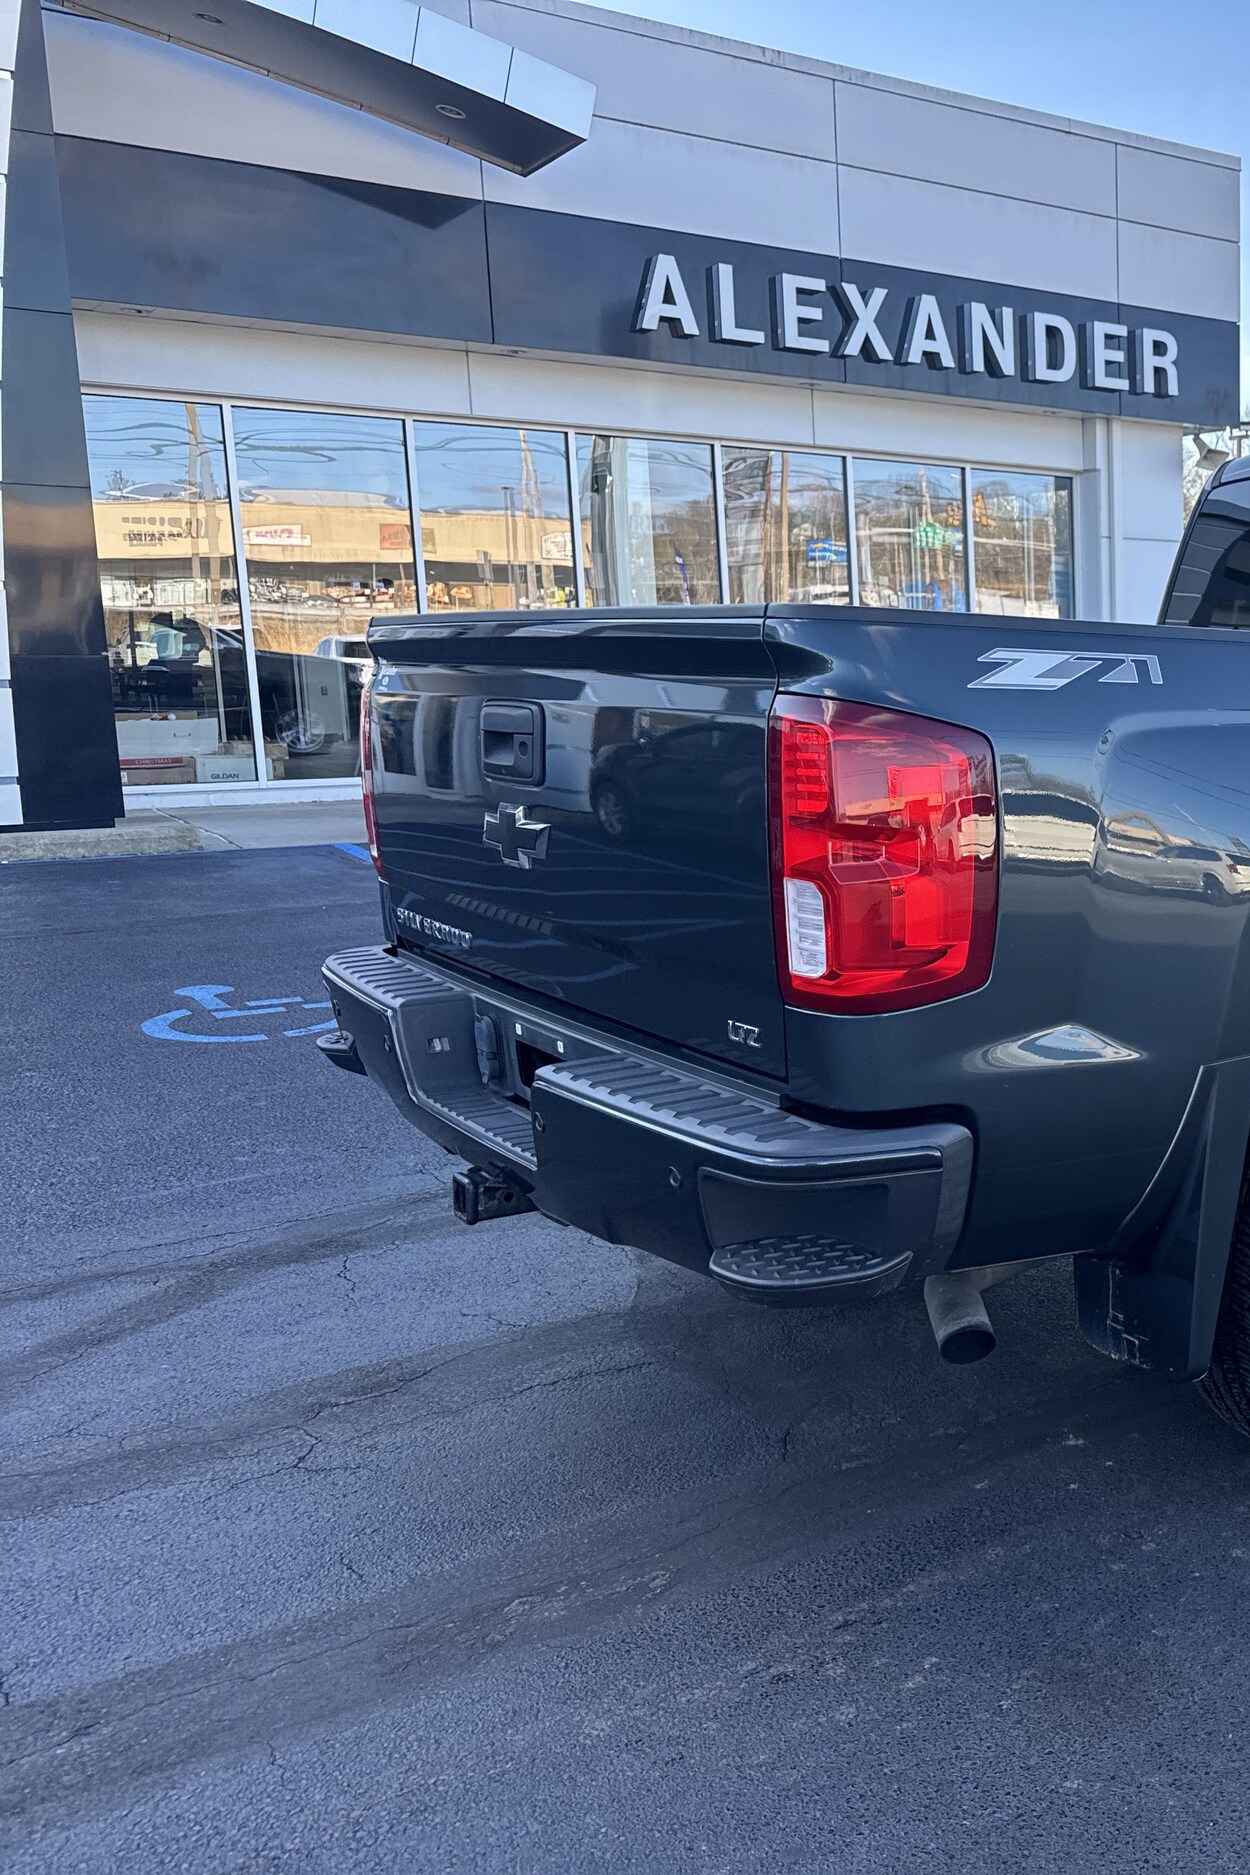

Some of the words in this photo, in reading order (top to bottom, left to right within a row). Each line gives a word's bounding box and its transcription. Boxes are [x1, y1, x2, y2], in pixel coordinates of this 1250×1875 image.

[632, 253, 1180, 398] ALEXANDER
[967, 647, 1164, 691] Z71
[396, 907, 473, 950] SILVERADO
[727, 1019, 761, 1048] LTZ
